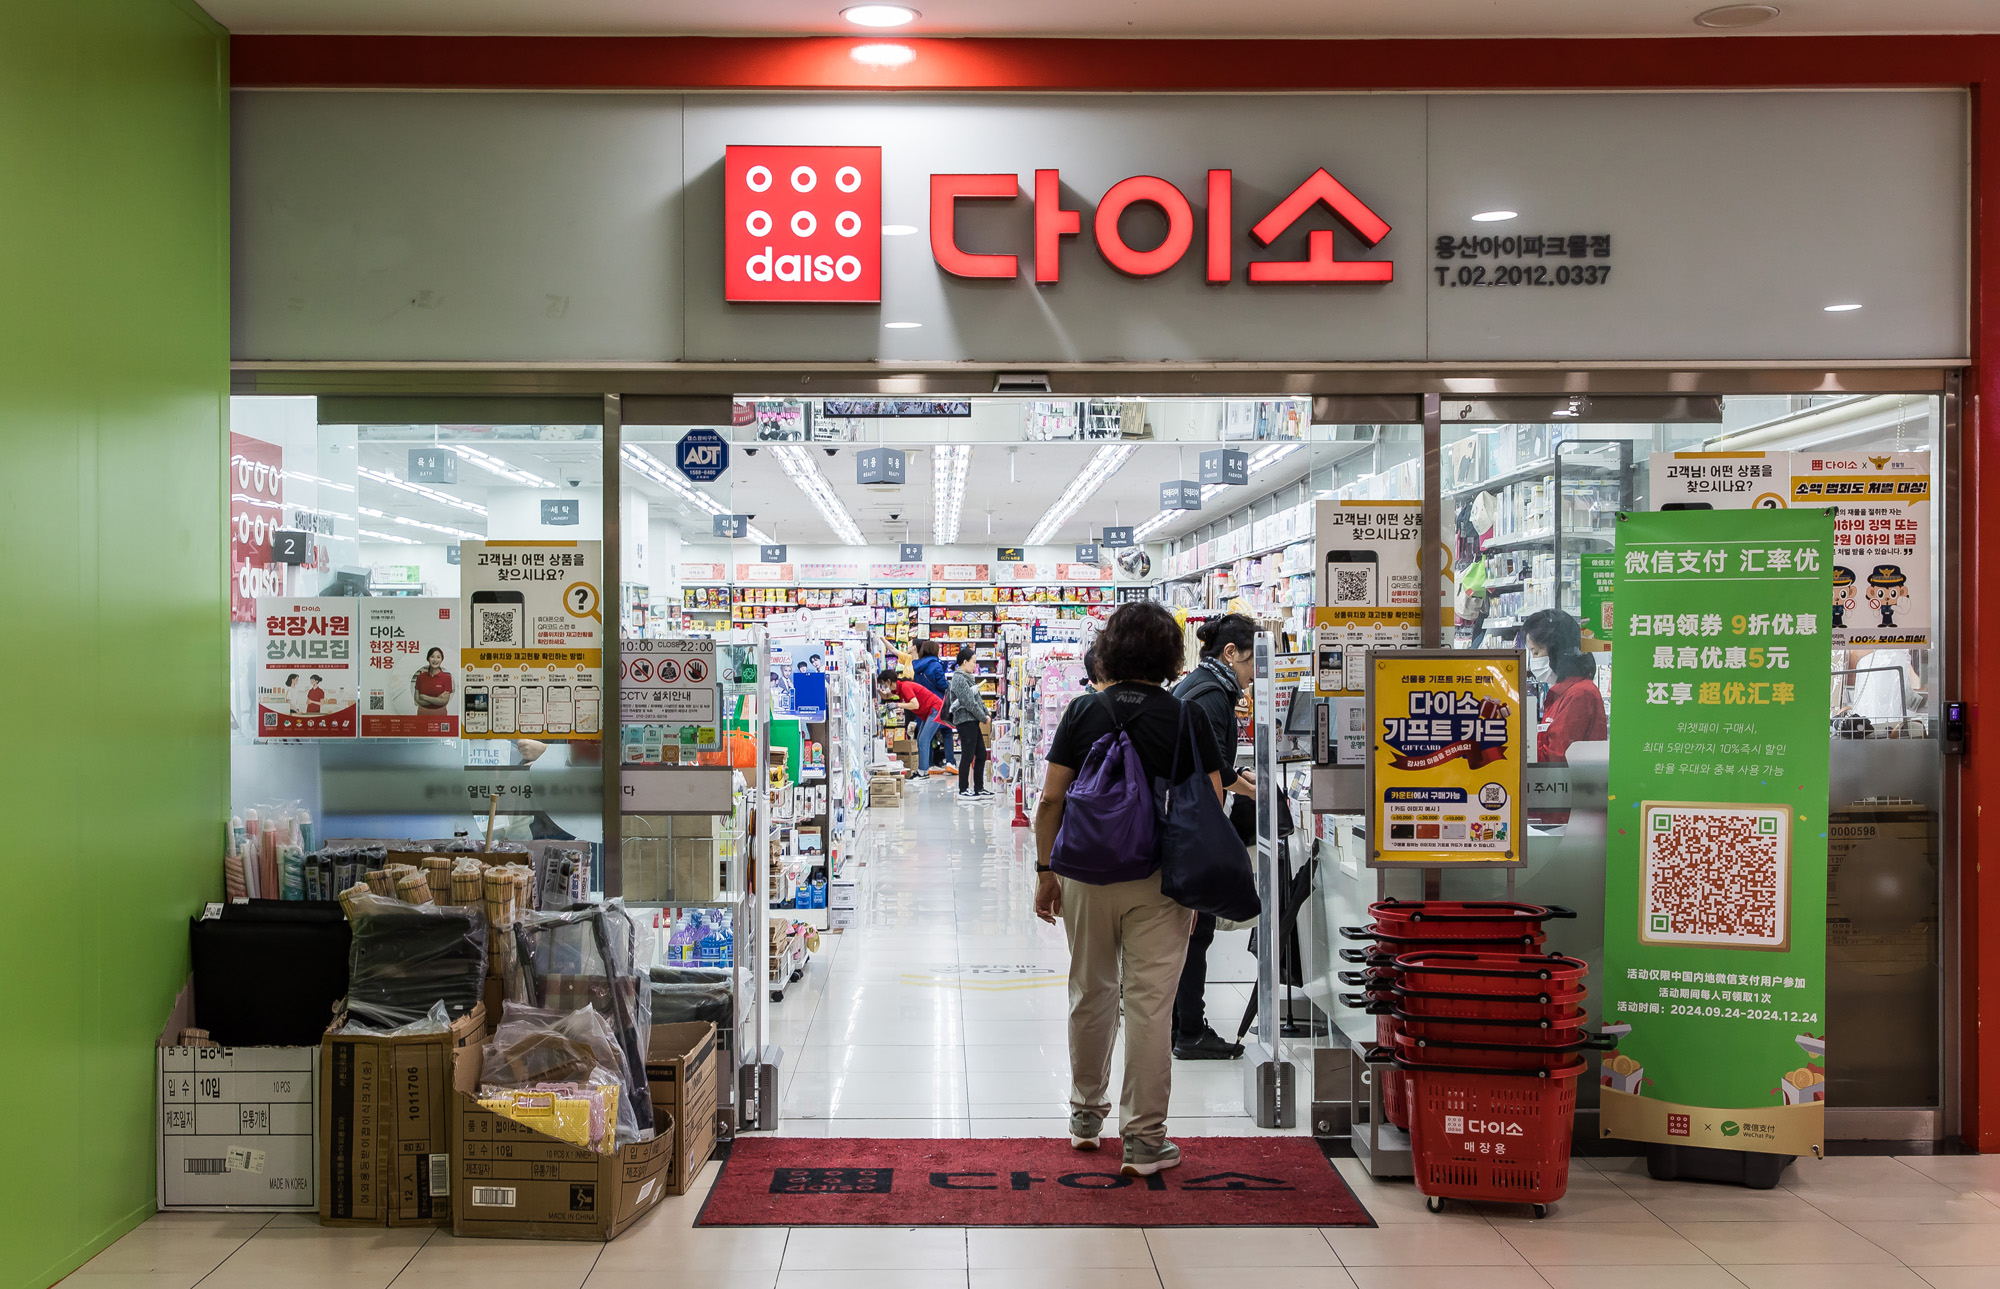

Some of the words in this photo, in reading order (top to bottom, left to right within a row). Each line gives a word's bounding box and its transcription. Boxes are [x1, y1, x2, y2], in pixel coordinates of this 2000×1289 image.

[929, 167, 1393, 285] 다이소
[1435, 235, 1611, 259] 용산아이파크몰점
[746, 245, 862, 283] daiso
[1435, 265, 1611, 287] T.02.2012.0337
[684, 446, 720, 465] ADT
[863, 457, 876, 468] 미용
[1205, 458, 1218, 470] 패션
[1229, 459, 1242, 470] 패션
[1825, 460, 1857, 469] 다이소
[1667, 465, 1706, 478] 고객님!
[1711, 465, 1734, 477] 어떤
[1737, 464, 1773, 477] 상품을
[1163, 488, 1179, 498] 인테리어
[1184, 488, 1199, 498] 인테리어
[1687, 480, 1753, 493] 찾으시나요?
[1796, 483, 1822, 494] 소액
[1825, 482, 1864, 494] 범죄도
[1867, 482, 1894, 493] 처벌
[1897, 482, 1927, 493] 대상!
[1333, 513, 1372, 526] 고객님!
[1376, 513, 1399, 526] 어떤
[1868, 519, 1891, 530] 징역
[1894, 519, 1918, 531] 또는
[1352, 528, 1419, 541] 찾으시나요?
[1855, 534, 1890, 545] 이하의
[1894, 534, 1916, 545] 벌금
[284, 539, 295, 555] 2
[478, 553, 517, 566] 고객님!
[521, 553, 545, 566] 어떤
[549, 553, 584, 567] 상품을
[1625, 548, 1728, 574] 微信支付
[1740, 547, 1820, 573] 汇率优
[240, 556, 279, 598] daiso
[498, 568, 564, 581] 찾으시나요?
[266, 616, 349, 636] 현장사원
[1086, 621, 1093, 631] 2
[1629, 613, 1723, 637] 扫码领券
[1731, 613, 1818, 636] 9折优惠
[370, 626, 405, 638] 다이소
[1849, 635, 1876, 643] 100%
[1878, 635, 1926, 644] 보이스피싱!
[266, 640, 349, 659] 상시모집
[370, 640, 394, 654] 현장
[395, 640, 419, 654] 직원
[621, 642, 653, 651] 10:00
[680, 642, 713, 651] 22:00
[370, 656, 394, 669] 채용
[1652, 646, 1790, 669] 最高优惠5元
[1401, 675, 1426, 683] 선물용
[1429, 675, 1453, 683] 기프트
[1456, 675, 1472, 683] 카드
[621, 691, 648, 700] CCTV
[652, 691, 691, 702] 설치안내
[1646, 682, 1693, 705] 还享
[1698, 681, 1795, 705] 超优汇率
[1410, 692, 1479, 715] 다이소
[1384, 719, 1452, 741] 기프트
[1460, 719, 1506, 741] 카드
[1677, 722, 1720, 734] 위챗페이
[1723, 722, 1758, 735] 구매시,
[1643, 743, 1664, 753] 최대
[1667, 743, 1716, 754] 5위안까지
[1720, 744, 1761, 755] 10%즉시
[1765, 744, 1787, 756] 할인
[1653, 763, 1675, 775] 환율
[1678, 764, 1711, 775] 우대와
[1713, 764, 1735, 775] 중복
[1738, 764, 1760, 776] 사용
[1762, 765, 1785, 777] 가능
[468, 785, 490, 799] 열린
[494, 785, 506, 797] 후
[510, 785, 533, 799] 이용
[1534, 783, 1568, 793] 주시기
[1391, 791, 1429, 800] 카운터에서
[1431, 791, 1460, 800] 구매가능
[1831, 827, 1876, 836] 0000598
[1627, 968, 1806, 989] 活动仅限中国内地微信支付用户参加
[1659, 987, 1772, 1004] 活动期间每人可领取1次
[200, 1076, 220, 1098] 10입
[273, 1081, 279, 1093] 10
[280, 1081, 291, 1093] PCS
[408, 1066, 420, 1121] 1011706
[166, 1111, 193, 1128] 제조일자
[242, 1110, 267, 1128] 유통기한
[495, 1121, 517, 1133] 접이식
[1468, 1119, 1524, 1137] 다이소
[1669, 1127, 1688, 1135] daiso
[1742, 1122, 1775, 1133] 微信支付
[1743, 1131, 1764, 1139] WeChat
[496, 1145, 513, 1157] 10입
[1464, 1141, 1506, 1155] 매장용
[465, 1163, 490, 1176] 제조일자
[533, 1163, 558, 1177] 유통기한
[269, 1178, 284, 1189] MADE
[285, 1178, 289, 1189] IN
[290, 1178, 307, 1190] KOREA
[929, 1170, 1298, 1193] 다이소
[404, 1190, 413, 1201] 12
[549, 1212, 565, 1220] MADE
[576, 1213, 595, 1221] CHINA
